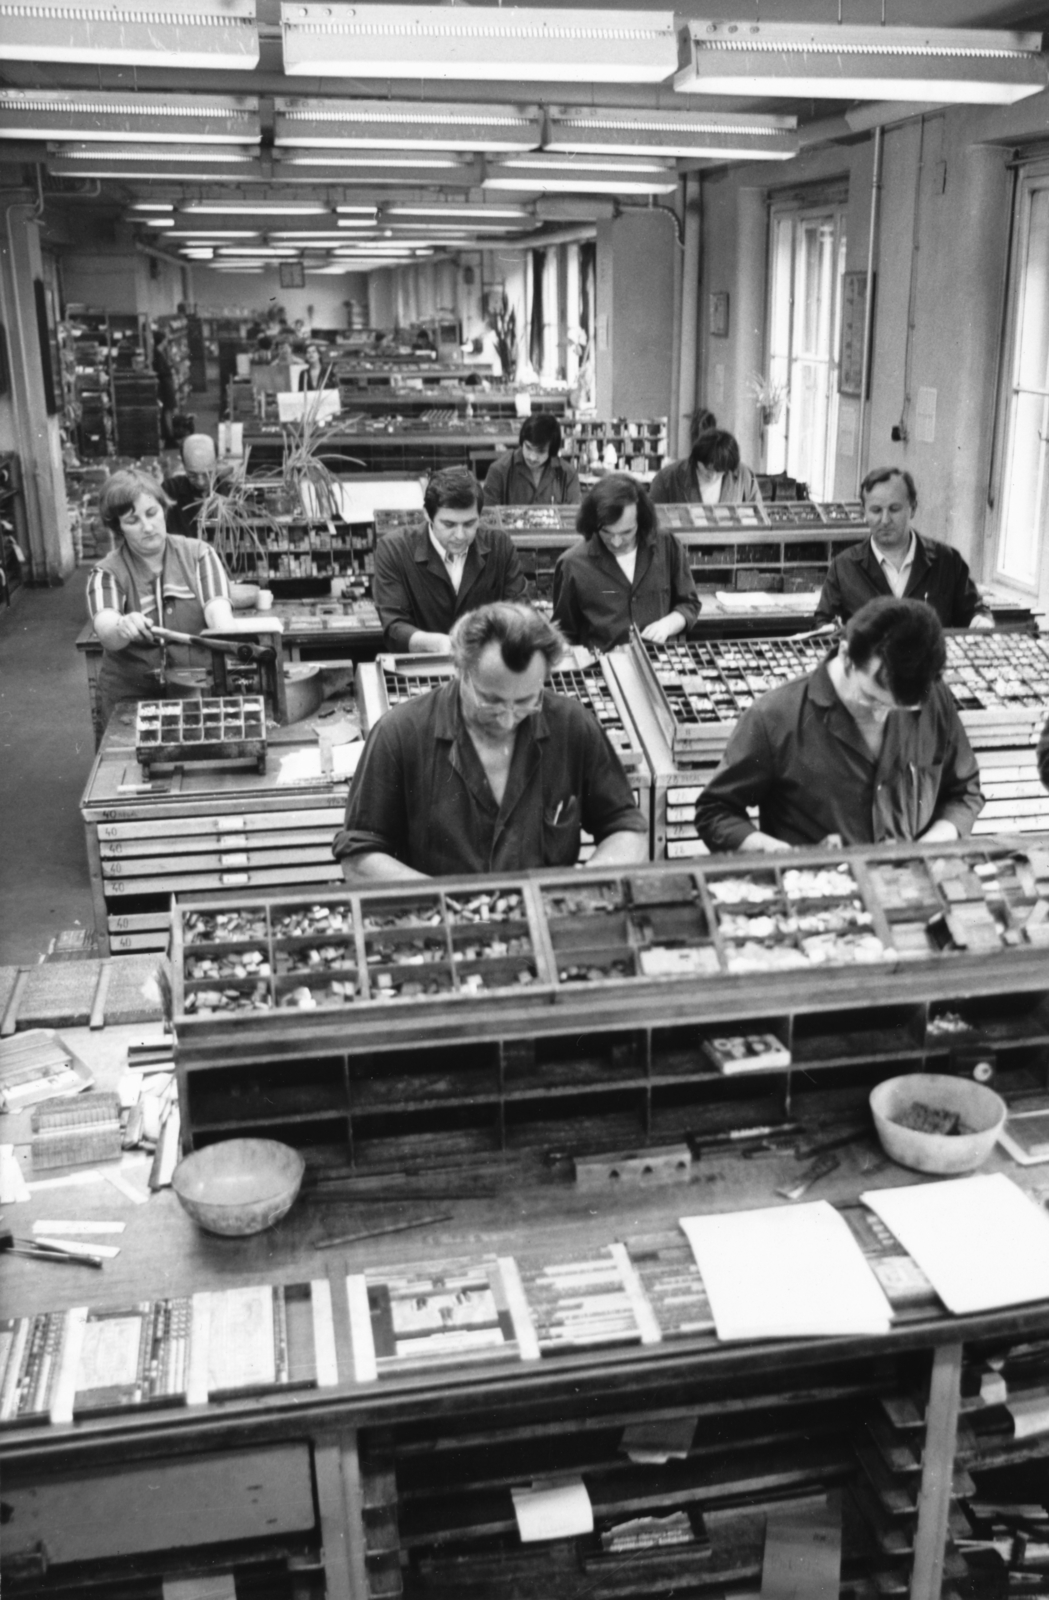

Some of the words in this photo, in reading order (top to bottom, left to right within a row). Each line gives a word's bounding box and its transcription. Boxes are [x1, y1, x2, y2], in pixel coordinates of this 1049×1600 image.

[105, 826, 118, 836] 40
[110, 862, 122, 874] 40
[112, 881, 125, 893] 40
[117, 917, 129, 929] 40
[119, 937, 132, 948] 40
